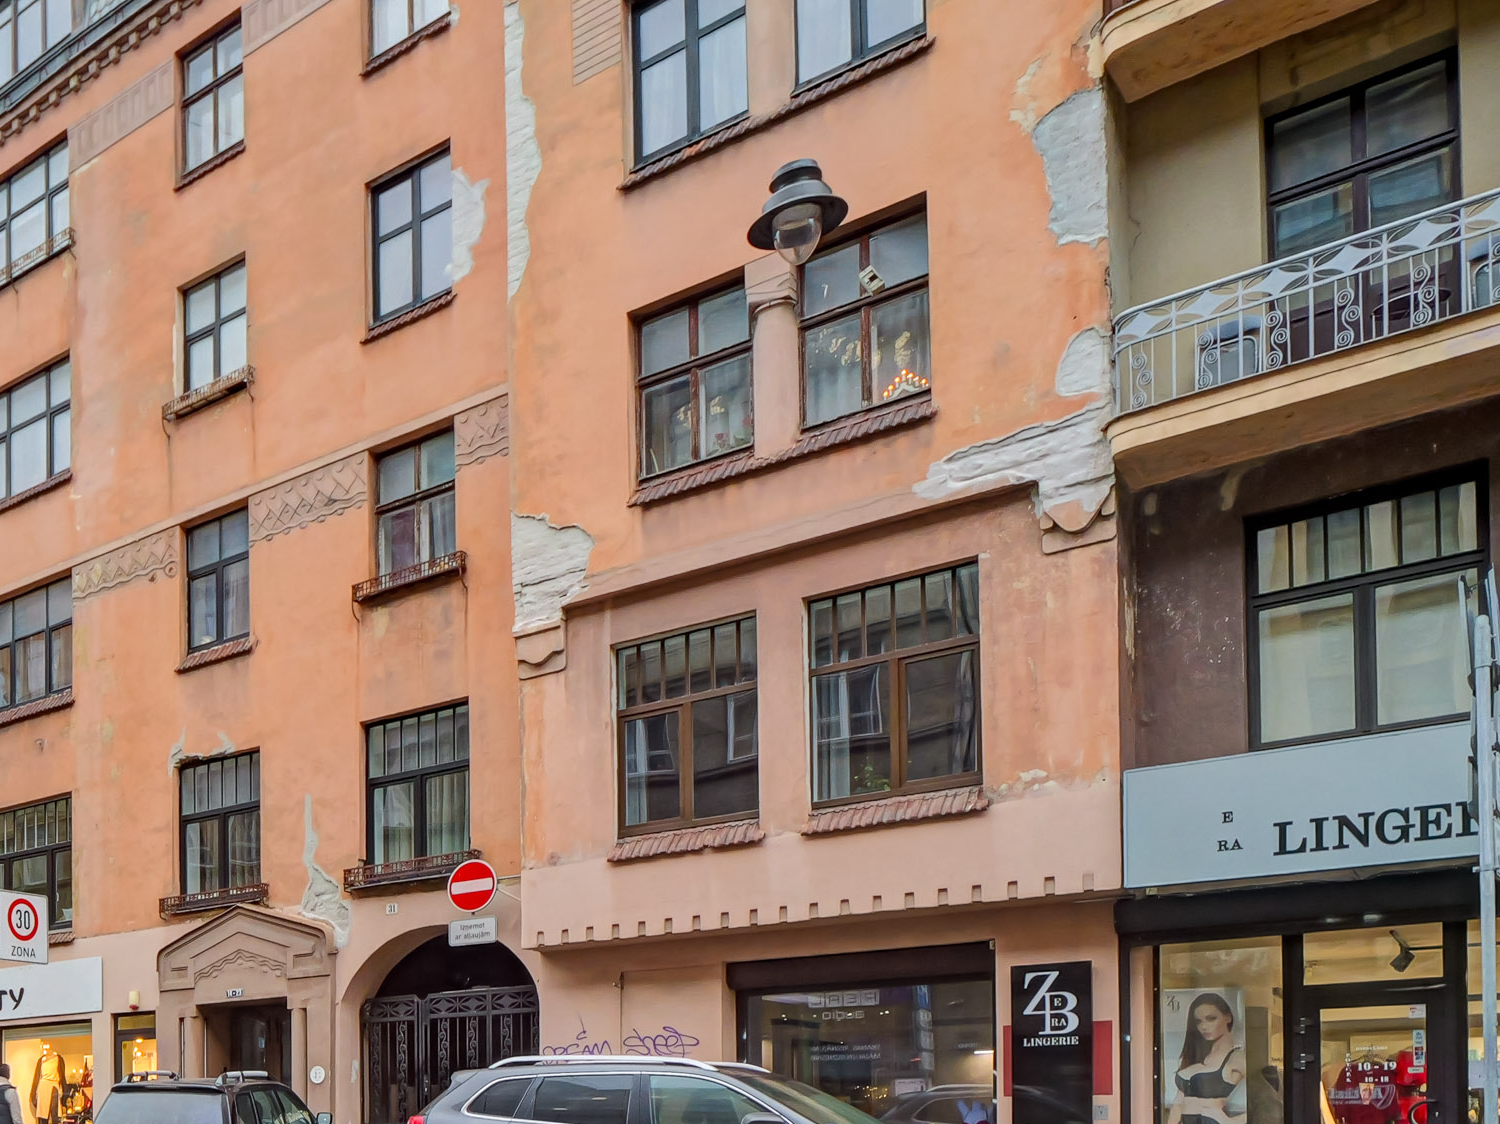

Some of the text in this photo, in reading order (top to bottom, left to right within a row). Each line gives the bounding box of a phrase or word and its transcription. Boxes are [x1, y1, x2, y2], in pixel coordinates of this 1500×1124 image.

[1222, 811, 1234, 824] E
[1217, 838, 1243, 852] RA
[15, 909, 31, 930] 30
[11, 945, 36, 958] ZONA
[1023, 1036, 1079, 1047] LINGERIE
[1357, 1062, 1372, 1072] 10
[1383, 1061, 1397, 1071] 19
